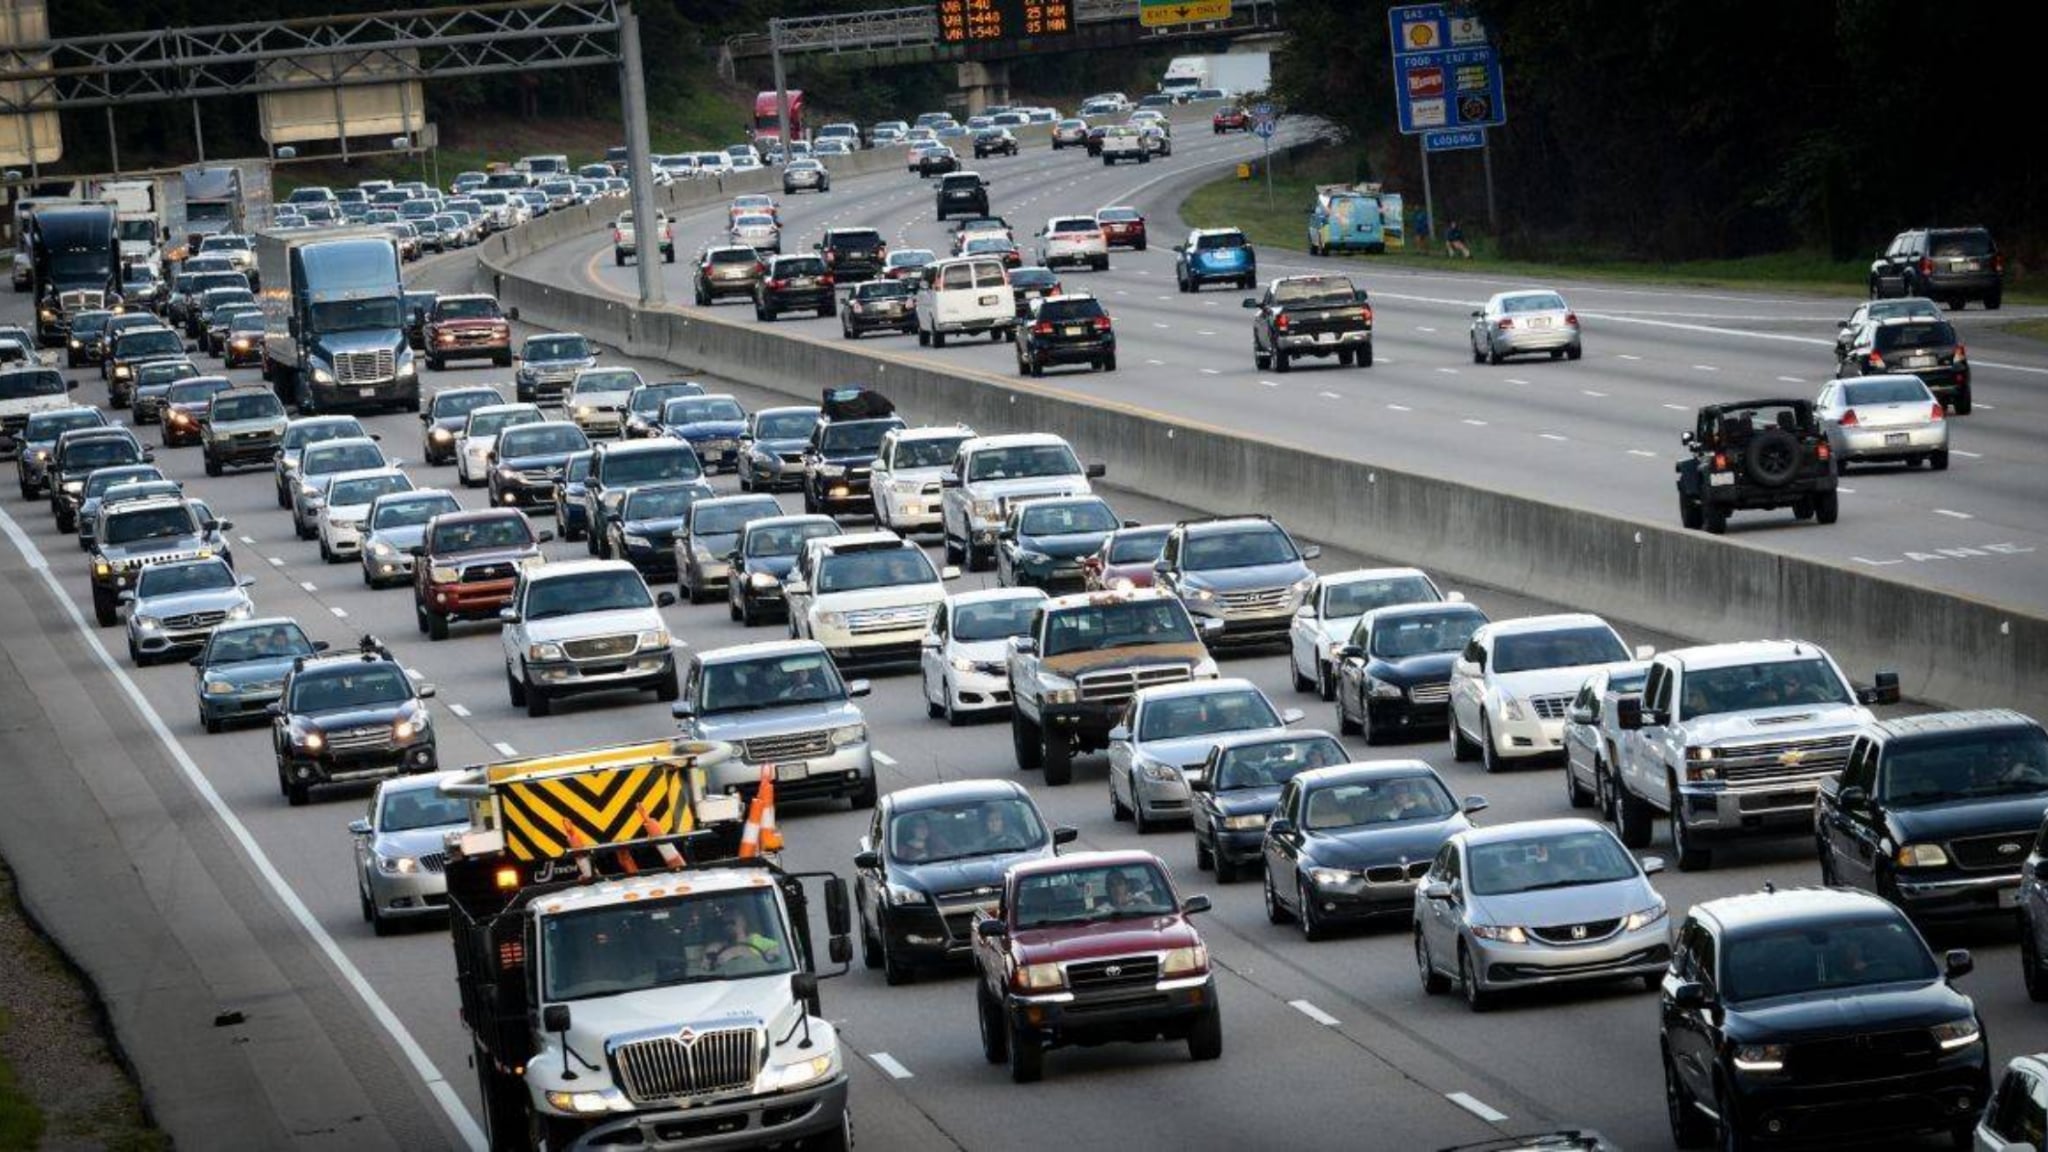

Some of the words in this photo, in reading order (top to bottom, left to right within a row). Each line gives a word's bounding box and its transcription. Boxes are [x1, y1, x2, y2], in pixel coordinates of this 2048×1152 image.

[1026, 6, 1041, 19] 25
[1147, 9, 1168, 19] EXIT
[1196, 4, 1223, 14] ONLY
[1404, 56, 1431, 68] FOOD
[1254, 120, 1274, 136] 40
[1433, 132, 1476, 147] LODGING
[1850, 542, 2036, 566] LANE
